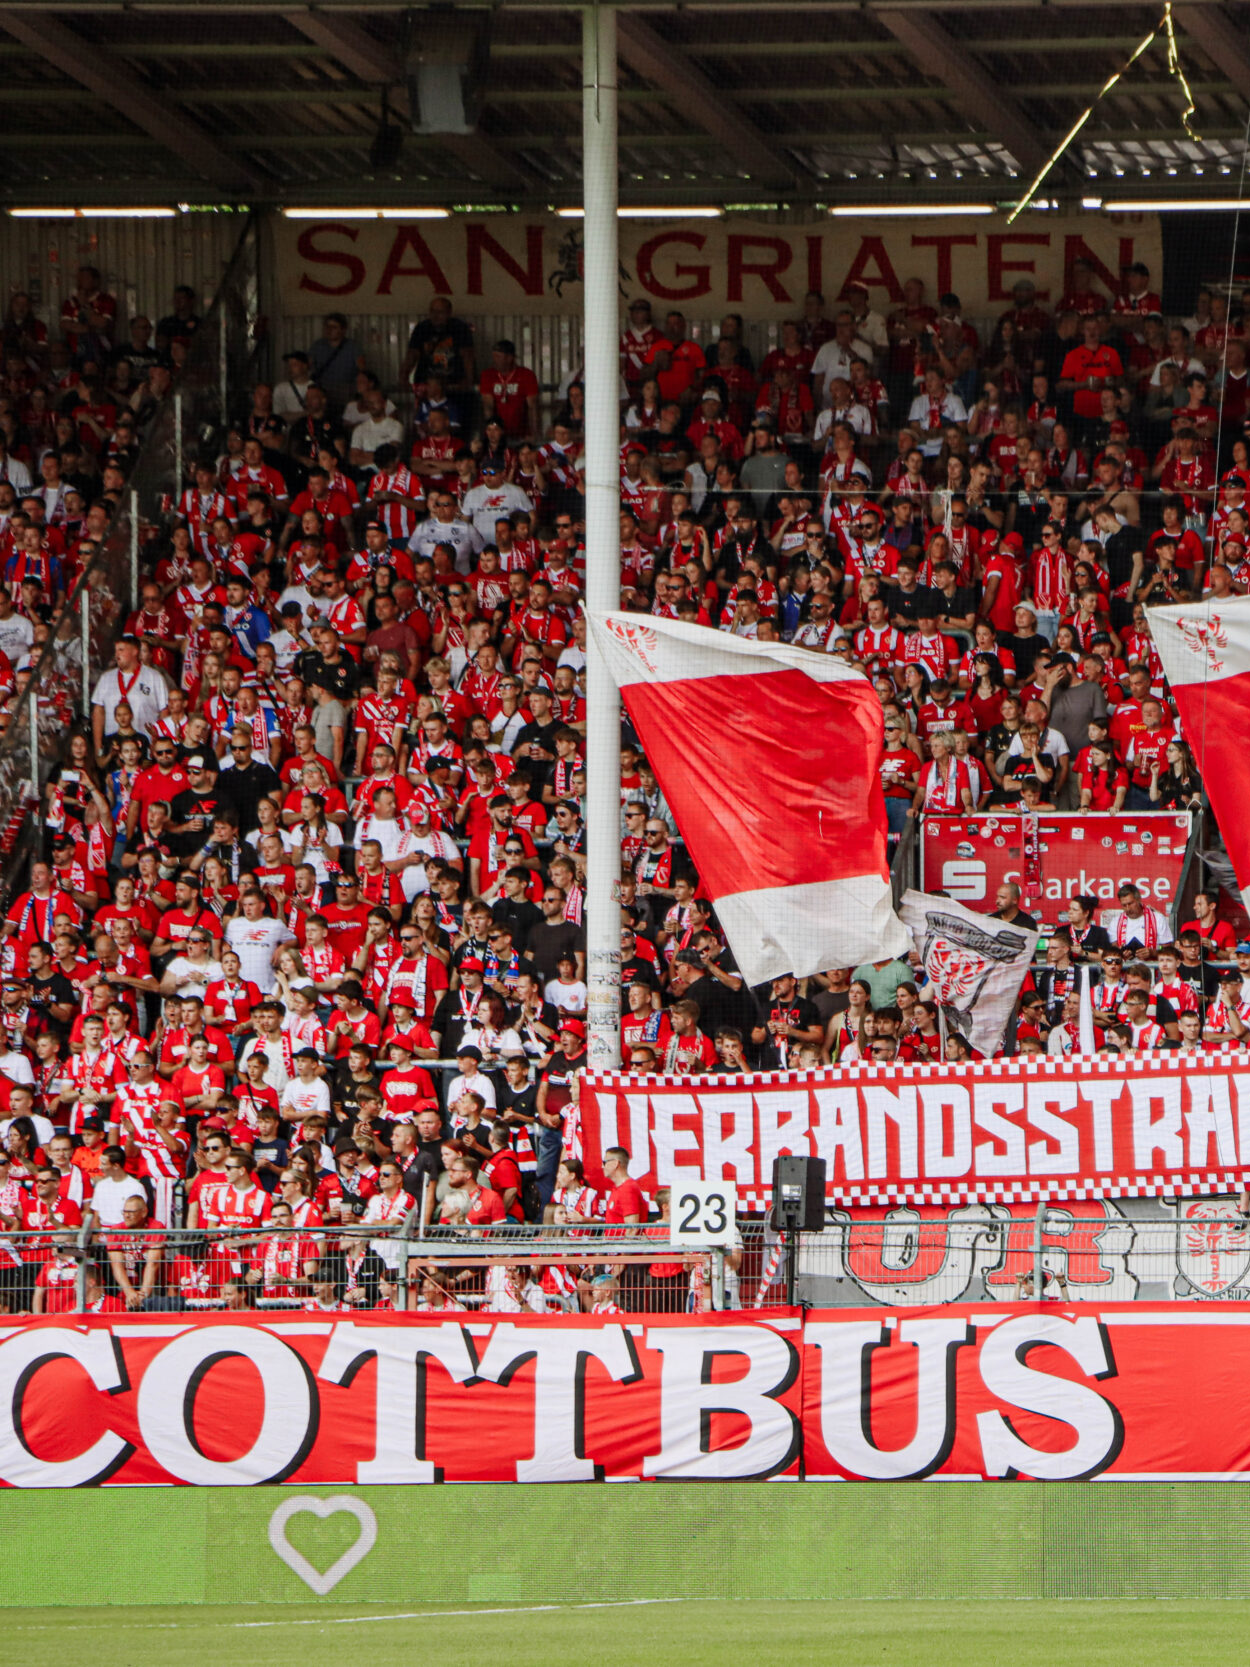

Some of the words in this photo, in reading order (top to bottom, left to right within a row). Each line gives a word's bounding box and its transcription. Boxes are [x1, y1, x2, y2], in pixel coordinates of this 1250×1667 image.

[298, 224, 545, 297] SAN
[636, 228, 1133, 304] GRIATEN
[678, 1193, 727, 1234] 23
[0, 1316, 1124, 1488] COTTBUS
